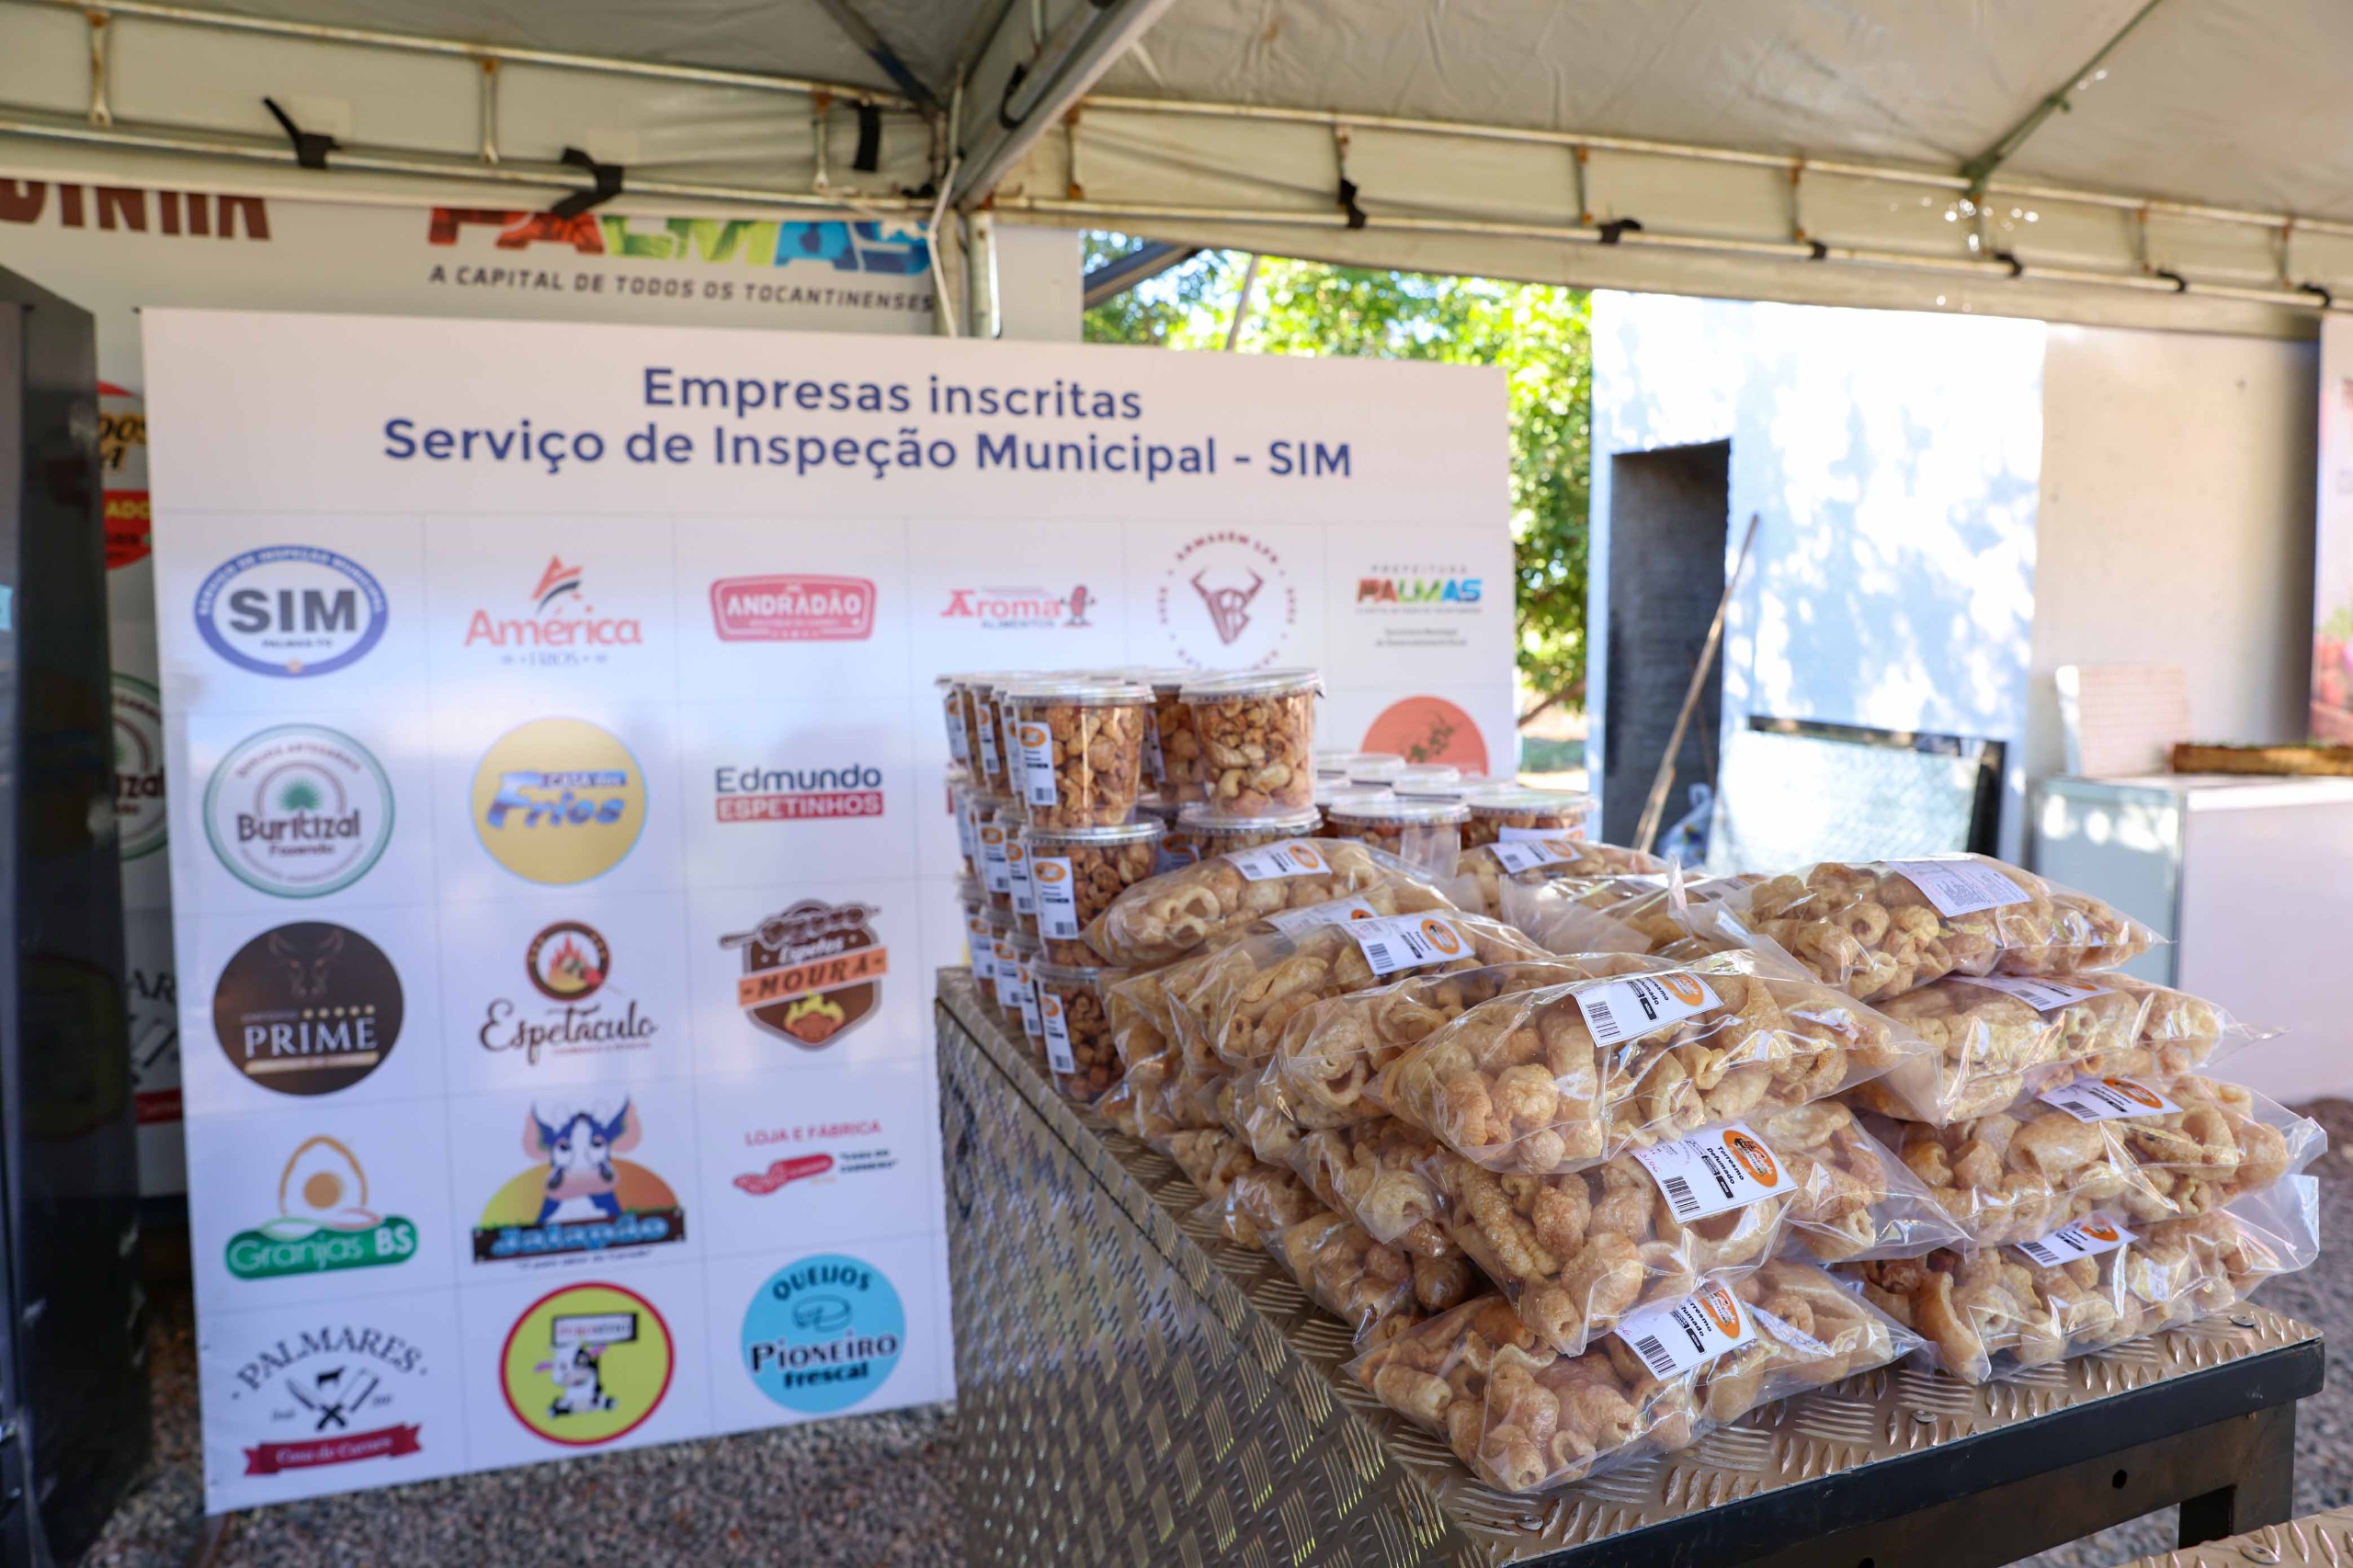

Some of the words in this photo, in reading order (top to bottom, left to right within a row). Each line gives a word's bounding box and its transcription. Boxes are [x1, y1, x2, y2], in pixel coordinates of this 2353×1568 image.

[429, 266, 446, 283] A
[457, 267, 563, 290] CAPITAL
[574, 273, 603, 292] DE
[616, 276, 694, 298] TODOS
[703, 281, 733, 300] OS
[745, 283, 933, 312] TOCANTINENSES
[644, 368, 911, 417] Empresas
[930, 375, 1142, 419] inscritas
[383, 419, 604, 473] Serviço
[626, 424, 692, 463] de
[715, 426, 957, 478] Inspeção
[976, 433, 1216, 482] Municipal
[1269, 441, 1351, 477] SIM
[229, 589, 356, 632] SIM
[940, 589, 1061, 618] Aroma
[1358, 579, 1482, 603] PALMAS
[463, 605, 642, 646] América
[716, 764, 882, 792] Edmundo
[719, 795, 880, 819] ESPETINHOS
[759, 955, 868, 998] MOURA
[244, 1018, 378, 1058] PRIME
[479, 998, 659, 1065] Espetáculo
[745, 1129, 789, 1146] LOJA
[793, 1127, 803, 1142] E
[1707, 1147, 1734, 1185] Defumado
[1717, 1145, 1745, 1181] Torresmo
[232, 1232, 364, 1271] Granjas
[375, 1224, 414, 1256] BS
[236, 1325, 423, 1391] PALMARES
[784, 1362, 870, 1390] frescal
